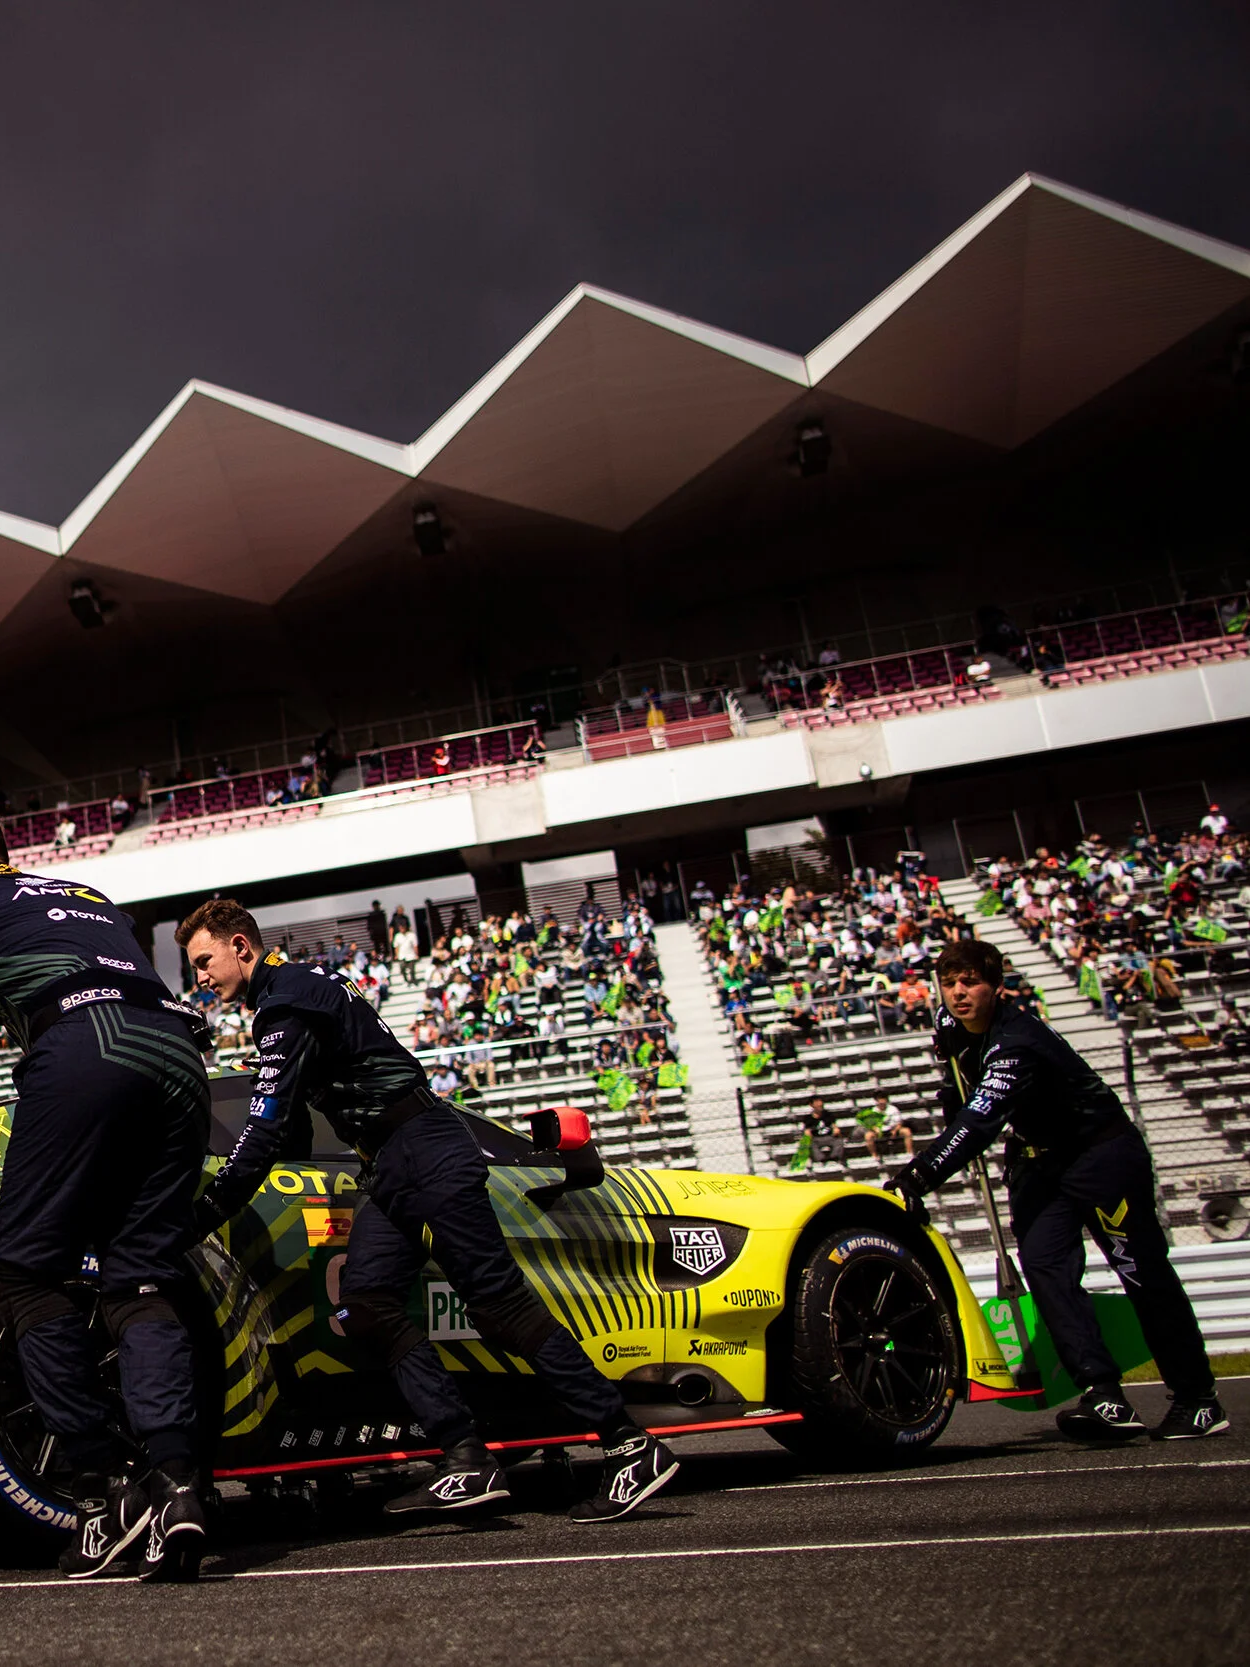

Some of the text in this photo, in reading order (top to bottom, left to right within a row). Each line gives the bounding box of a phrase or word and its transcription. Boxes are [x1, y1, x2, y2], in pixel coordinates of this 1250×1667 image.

[66, 909, 114, 924] TOTAL
[61, 986, 122, 1009] sparco
[262, 1053, 286, 1062] TOTAL
[992, 1072, 1017, 1080] TOTAL
[942, 1126, 970, 1160] MARTIN
[258, 1170, 357, 1195] OTA
[674, 1231, 715, 1246] TAG
[846, 1236, 899, 1254] MICHELIN
[676, 1248, 722, 1271] HEUER
[730, 1288, 777, 1307] DUPONT
[431, 1291, 475, 1331] PR
